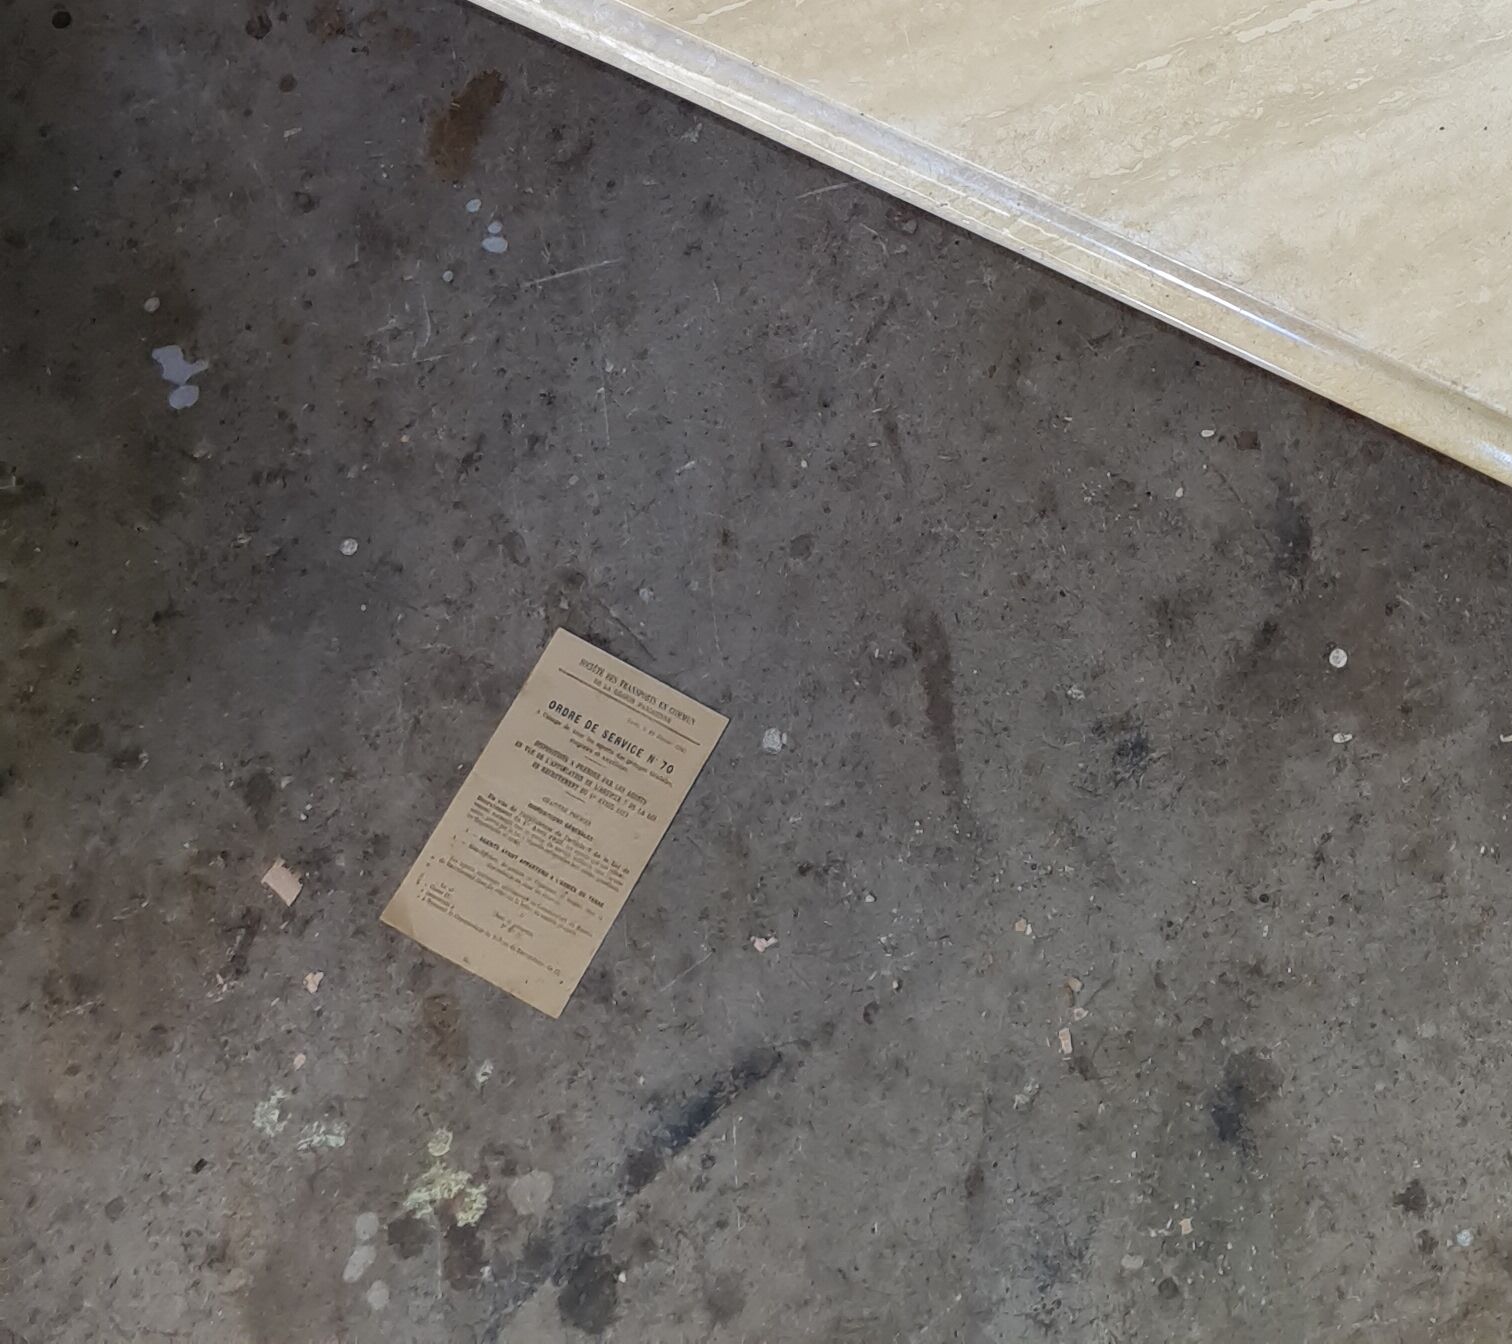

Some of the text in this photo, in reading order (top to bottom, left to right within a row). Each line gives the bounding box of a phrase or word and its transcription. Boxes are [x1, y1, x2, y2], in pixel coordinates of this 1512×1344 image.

[548, 700, 581, 723] ORDRE
[584, 720, 598, 732] DE
[602, 729, 643, 757] SERVICE
[660, 761, 674, 774] 70
